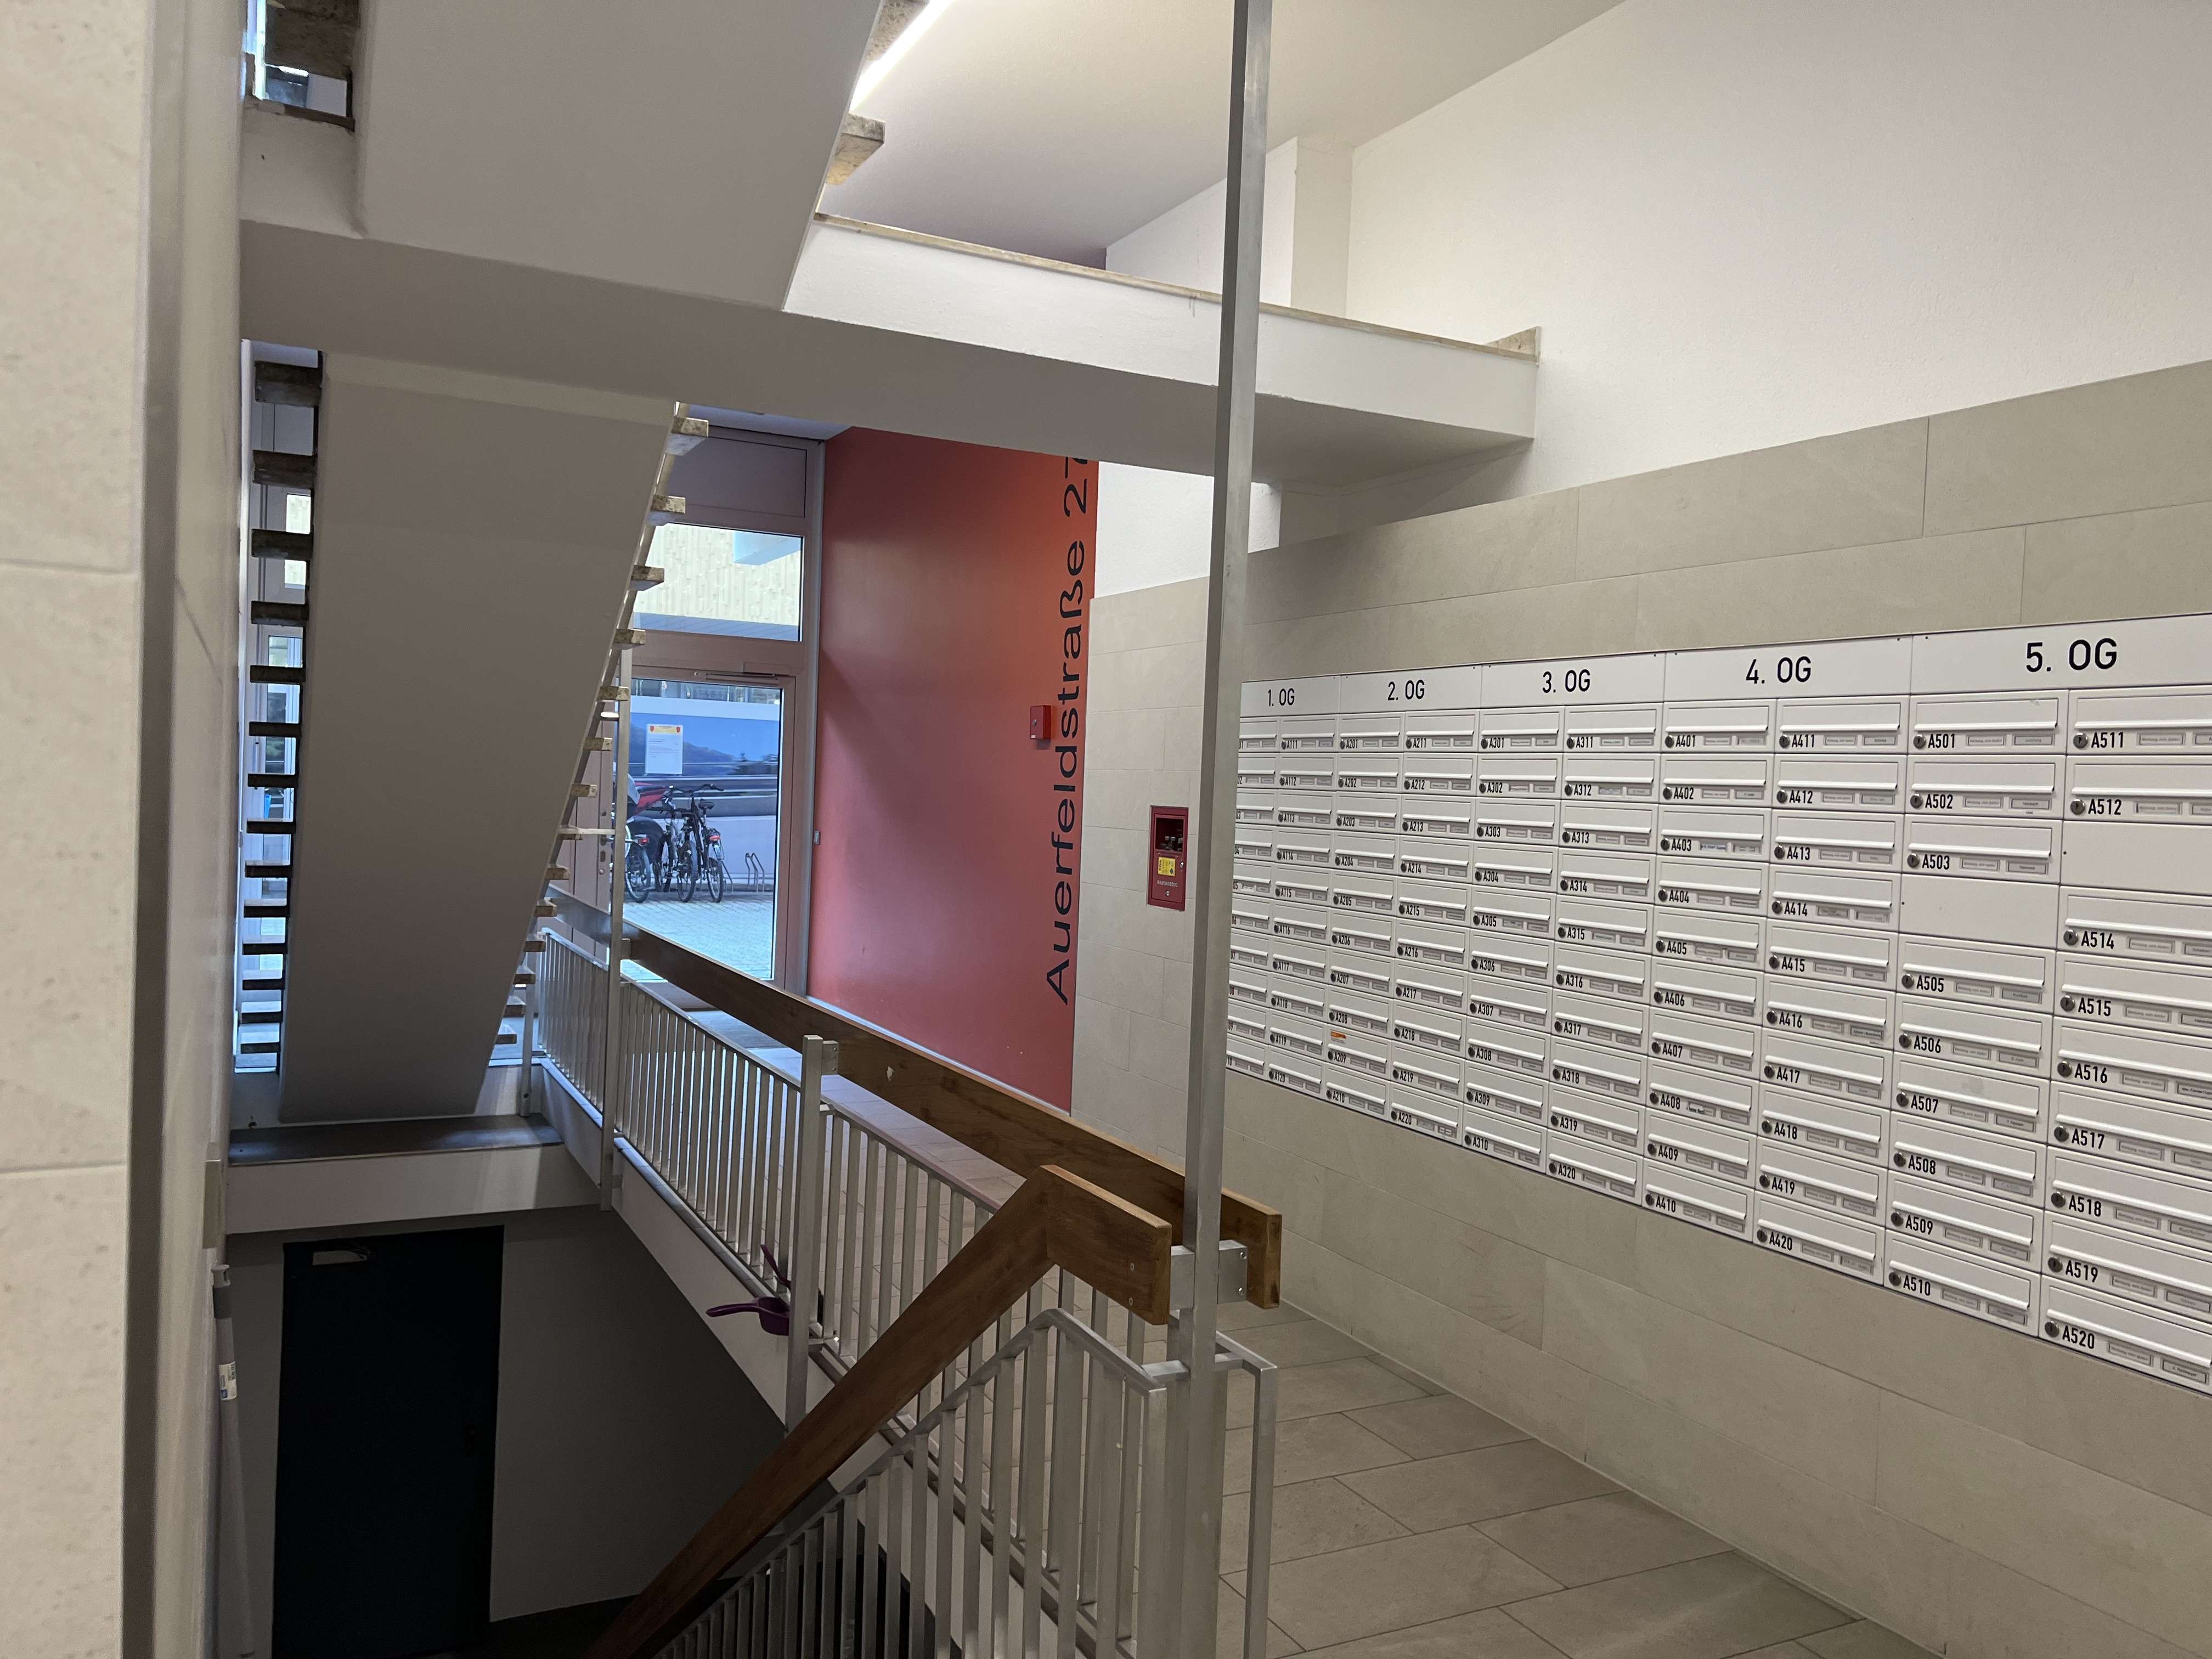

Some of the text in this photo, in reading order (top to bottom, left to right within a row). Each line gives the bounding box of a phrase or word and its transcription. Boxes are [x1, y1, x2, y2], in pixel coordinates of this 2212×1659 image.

[2026, 637, 2117, 673] 5. OG
[1746, 656, 1811, 684] 4. OG
[1542, 669, 1590, 693] 3. OG
[1387, 679, 1425, 701] 2. OG
[1268, 688, 1295, 707] 1. OG
[1286, 740, 1297, 749] A111
[1346, 738, 1358, 749] A201
[1413, 737, 1426, 748] A211
[1489, 737, 1505, 748] A301
[1576, 736, 1593, 748] A311
[1675, 734, 1696, 747] A401
[1791, 733, 1815, 748] A411
[1928, 733, 1955, 748] A501
[2091, 731, 2124, 748] A511
[1047, 540, 1085, 1006] Auerfeldstraße
[1285, 776, 1296, 786] A112
[1345, 777, 1357, 788] A202
[1410, 779, 1425, 790] A212
[1487, 782, 1503, 793] A302
[1573, 783, 1592, 796] A312
[1673, 787, 1694, 800] A402
[1789, 789, 1813, 804] A412
[1925, 793, 1953, 809] A502
[2088, 798, 2121, 815] A512
[1284, 813, 1295, 823] A113
[1342, 816, 1355, 827] A203
[1409, 821, 1423, 832] A213
[1485, 826, 1500, 838] A303
[1571, 831, 1589, 844] A313
[1671, 838, 1691, 851] A403
[1282, 851, 1293, 861] A114
[1787, 845, 1810, 861] A413
[1341, 856, 1353, 866] A204
[1408, 862, 1421, 874] A214
[1922, 854, 1950, 870] A503
[1483, 870, 1499, 883] A304
[1570, 879, 1587, 892] A314
[1280, 888, 1292, 898] A115
[1340, 894, 1352, 906] A205
[1669, 889, 1689, 904] A404
[1406, 904, 1420, 916] A215
[1784, 901, 1808, 917] A414
[1481, 915, 1497, 927] A305
[1279, 922, 1291, 935] A116
[1567, 926, 1585, 940] A315
[1338, 933, 1350, 946] A206
[2081, 930, 2114, 949] A514
[1404, 945, 1419, 958] A216
[1667, 940, 1687, 955] A405
[1278, 960, 1289, 971] A117
[1479, 958, 1496, 972] A306
[1781, 956, 1805, 972] A415
[1337, 973, 1349, 984] A207
[1565, 974, 1583, 988] A316
[1916, 974, 1944, 992] A505
[1402, 986, 1417, 999] A217
[1664, 992, 1684, 1007] A406
[1277, 997, 1288, 1009] A118
[1477, 1002, 1494, 1017] A307
[2078, 997, 2113, 1017] A515
[1335, 1010, 1348, 1024] A208
[1779, 1011, 1802, 1028] A416
[1401, 1028, 1415, 1041] A218
[1564, 1021, 1581, 1036] A317
[1275, 1033, 1287, 1046] A119
[1914, 1035, 1942, 1053] A506
[1334, 1049, 1347, 1063] A209
[1476, 1047, 1492, 1061] A308
[1662, 1042, 1683, 1058] A407
[1274, 1071, 1285, 1083] A120
[1399, 1069, 1414, 1083] A219
[1561, 1067, 1579, 1084] A318
[1776, 1066, 1801, 1084] A417
[2074, 1063, 2107, 1084] A516
[1333, 1090, 1345, 1103] A210
[1474, 1091, 1490, 1105] A309
[1660, 1093, 1680, 1110] A408
[1911, 1094, 1939, 1113] A507
[1398, 1111, 1412, 1125] A220
[1560, 1116, 1578, 1132] A319
[1774, 1121, 1797, 1140] A418
[1472, 1136, 1488, 1150] A310
[2071, 1128, 2105, 1149] A517
[1658, 1144, 1678, 1161] A409
[1908, 1154, 1936, 1175] A508
[1558, 1164, 1576, 1180] A320
[1771, 1176, 1795, 1195] A419
[1655, 1195, 1676, 1213] A410
[2068, 1194, 2102, 1218] A518
[1905, 1214, 1933, 1236] A509
[1769, 1231, 1793, 1251] A420
[2065, 1260, 2098, 1283] A519
[1902, 1275, 1931, 1297] A510
[2062, 1325, 2095, 1350] A520
